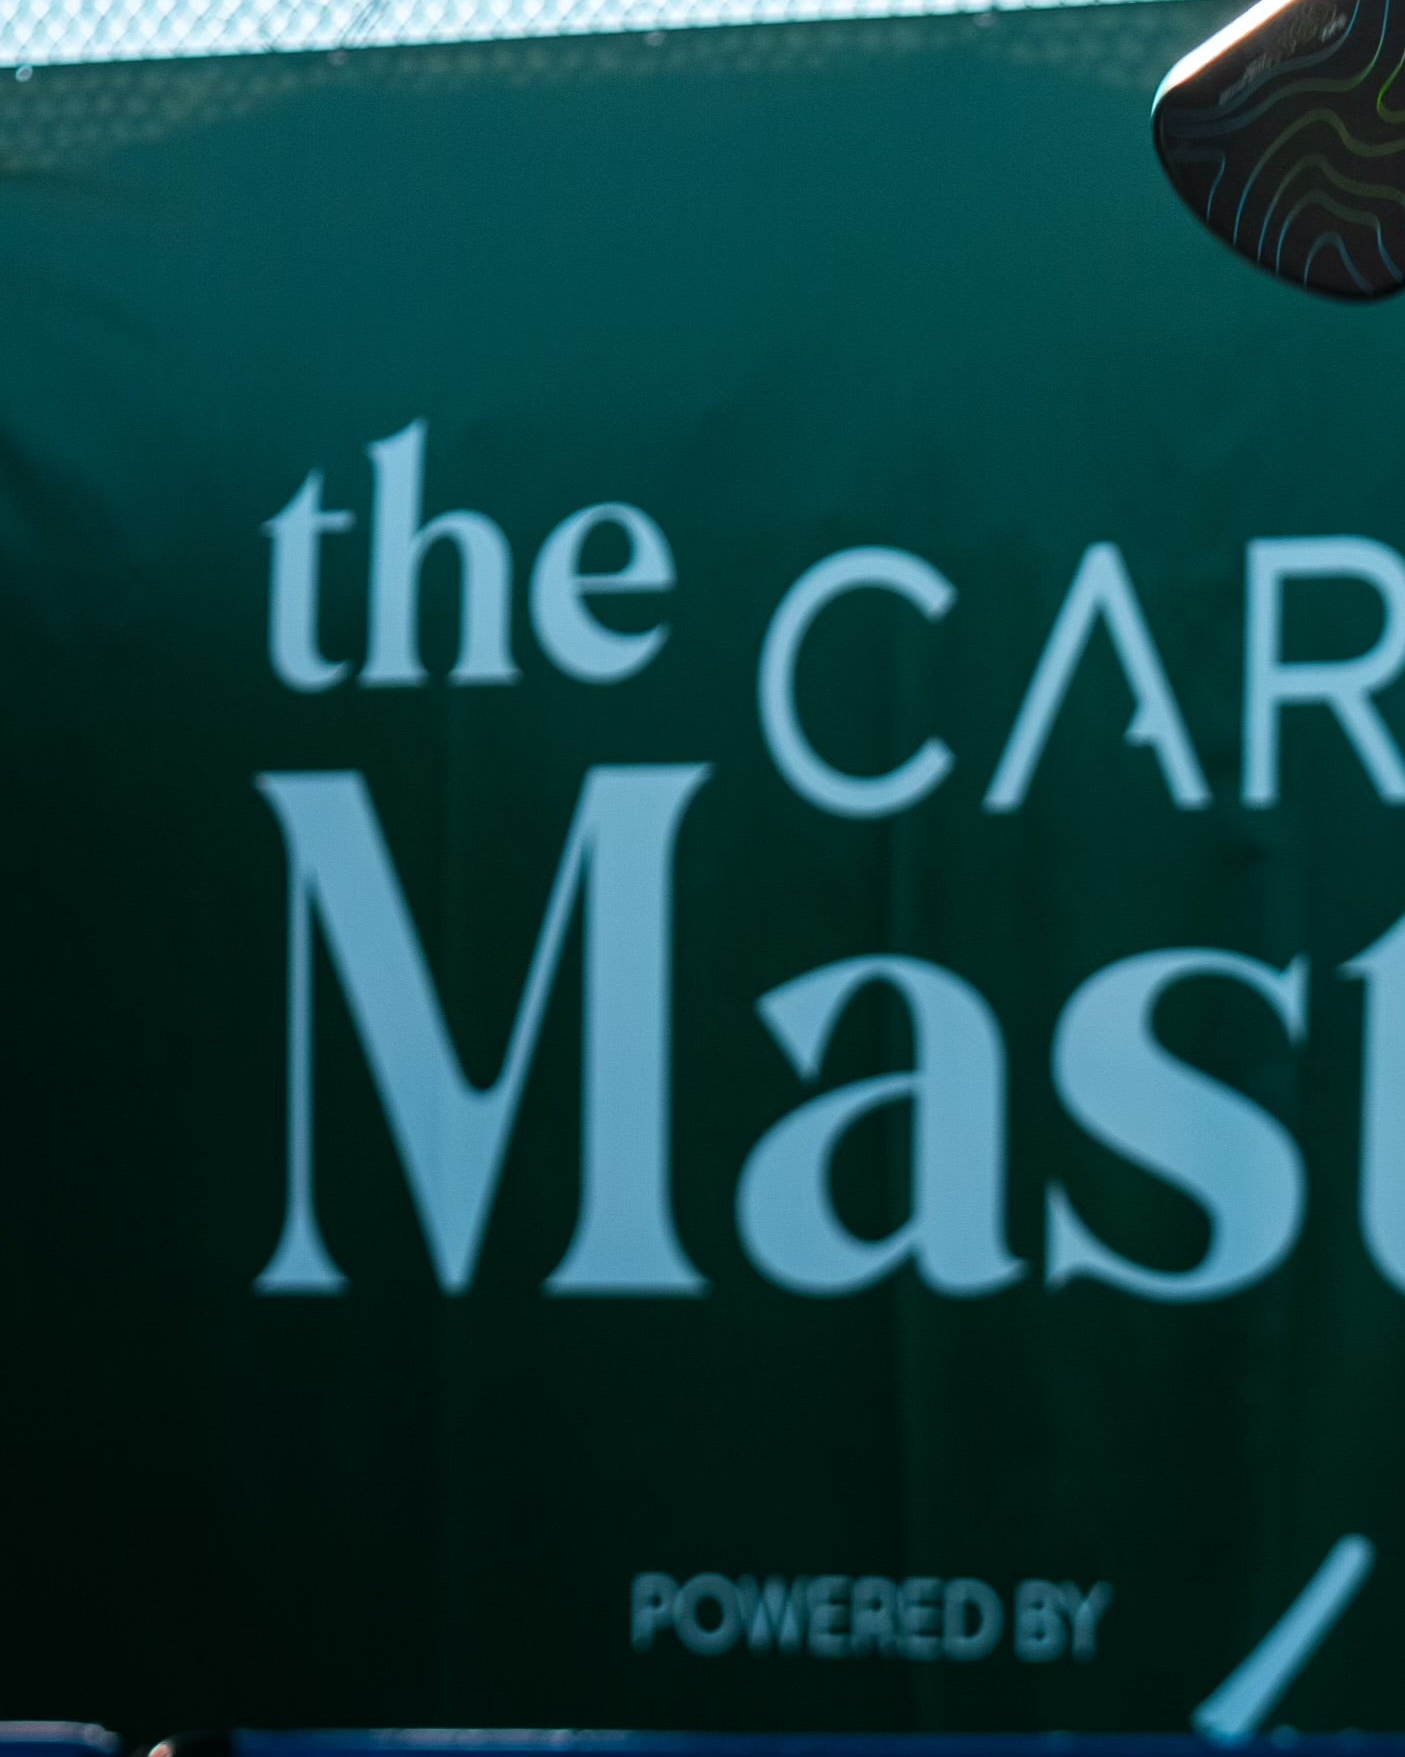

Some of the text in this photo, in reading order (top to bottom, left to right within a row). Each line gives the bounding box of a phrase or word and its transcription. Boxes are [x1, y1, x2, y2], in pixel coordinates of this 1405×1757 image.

[260, 417, 676, 692] the
[630, 1571, 1114, 1665] POWERED BY
